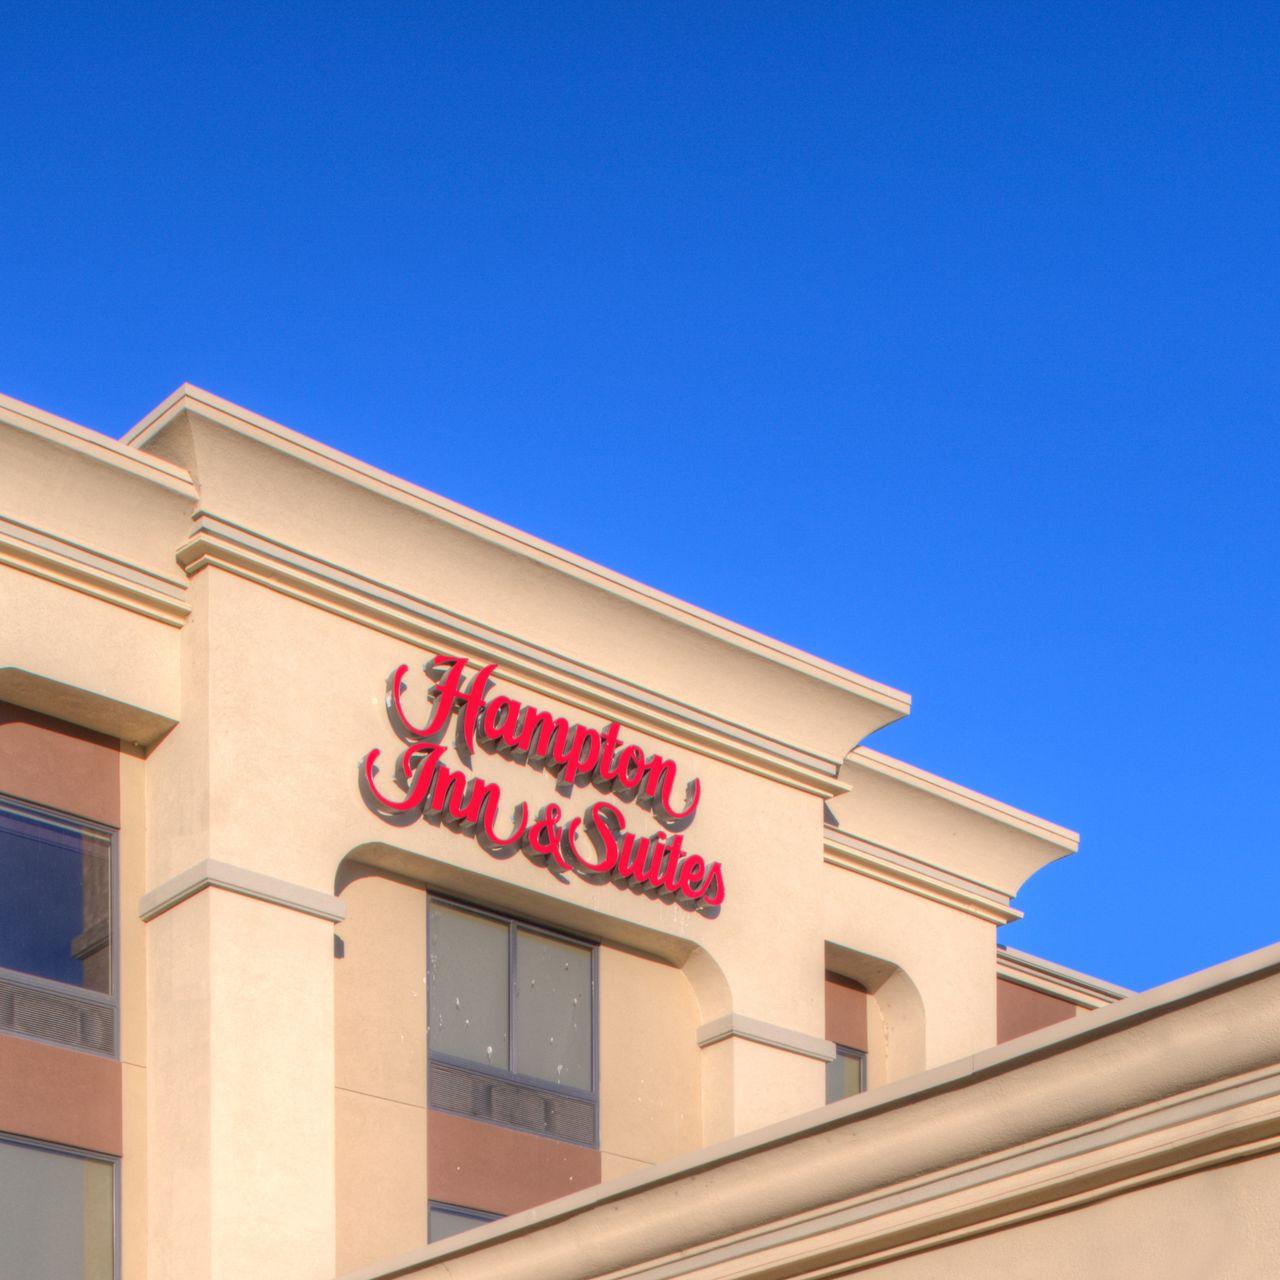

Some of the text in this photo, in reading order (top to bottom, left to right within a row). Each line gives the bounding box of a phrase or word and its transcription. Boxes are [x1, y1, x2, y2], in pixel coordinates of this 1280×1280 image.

[393, 655, 701, 819] Hampton
[365, 742, 725, 906] Inn & Suites
